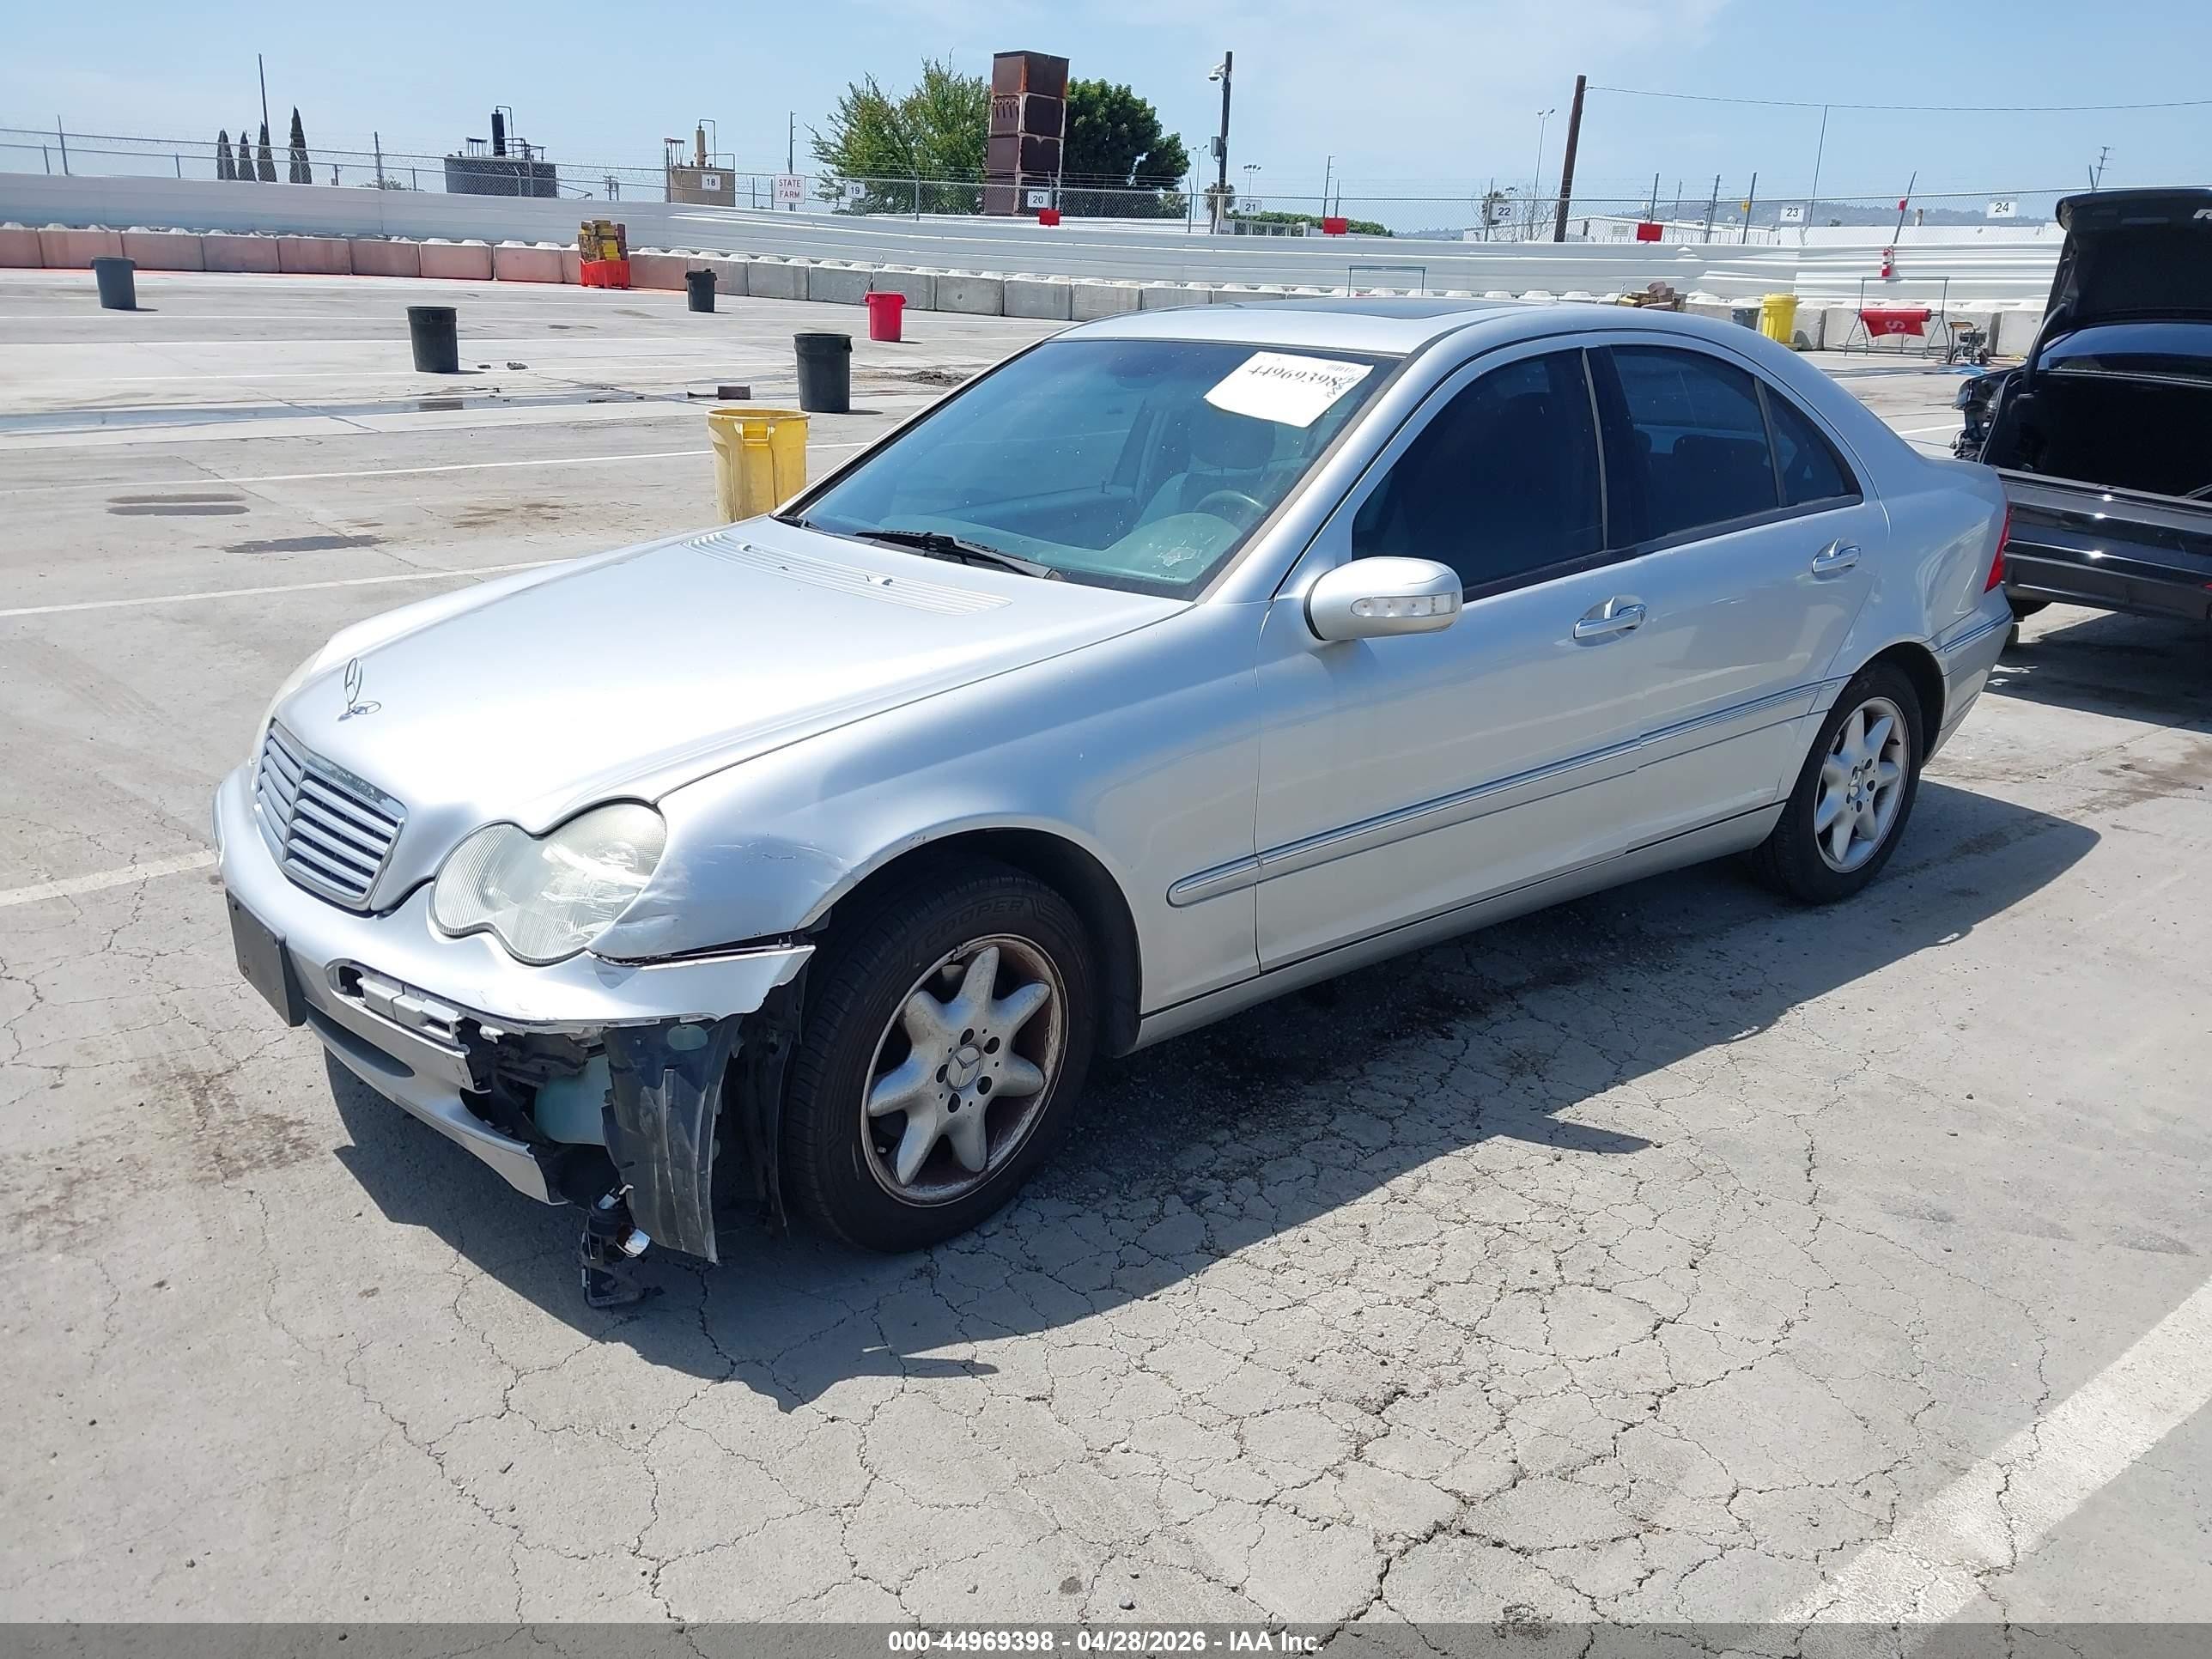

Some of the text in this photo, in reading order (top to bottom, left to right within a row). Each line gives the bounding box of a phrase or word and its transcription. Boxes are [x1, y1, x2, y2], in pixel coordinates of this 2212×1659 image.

[778, 179, 801, 188] STATE
[779, 190, 800, 199] FARM
[850, 186, 860, 195] 19
[1032, 195, 1044, 204] 20
[1245, 204, 1256, 212] 21
[1498, 207, 1511, 216] 22
[1786, 207, 1799, 217] 23
[1995, 202, 2009, 213] 24
[1248, 365, 1339, 387] 44969398
